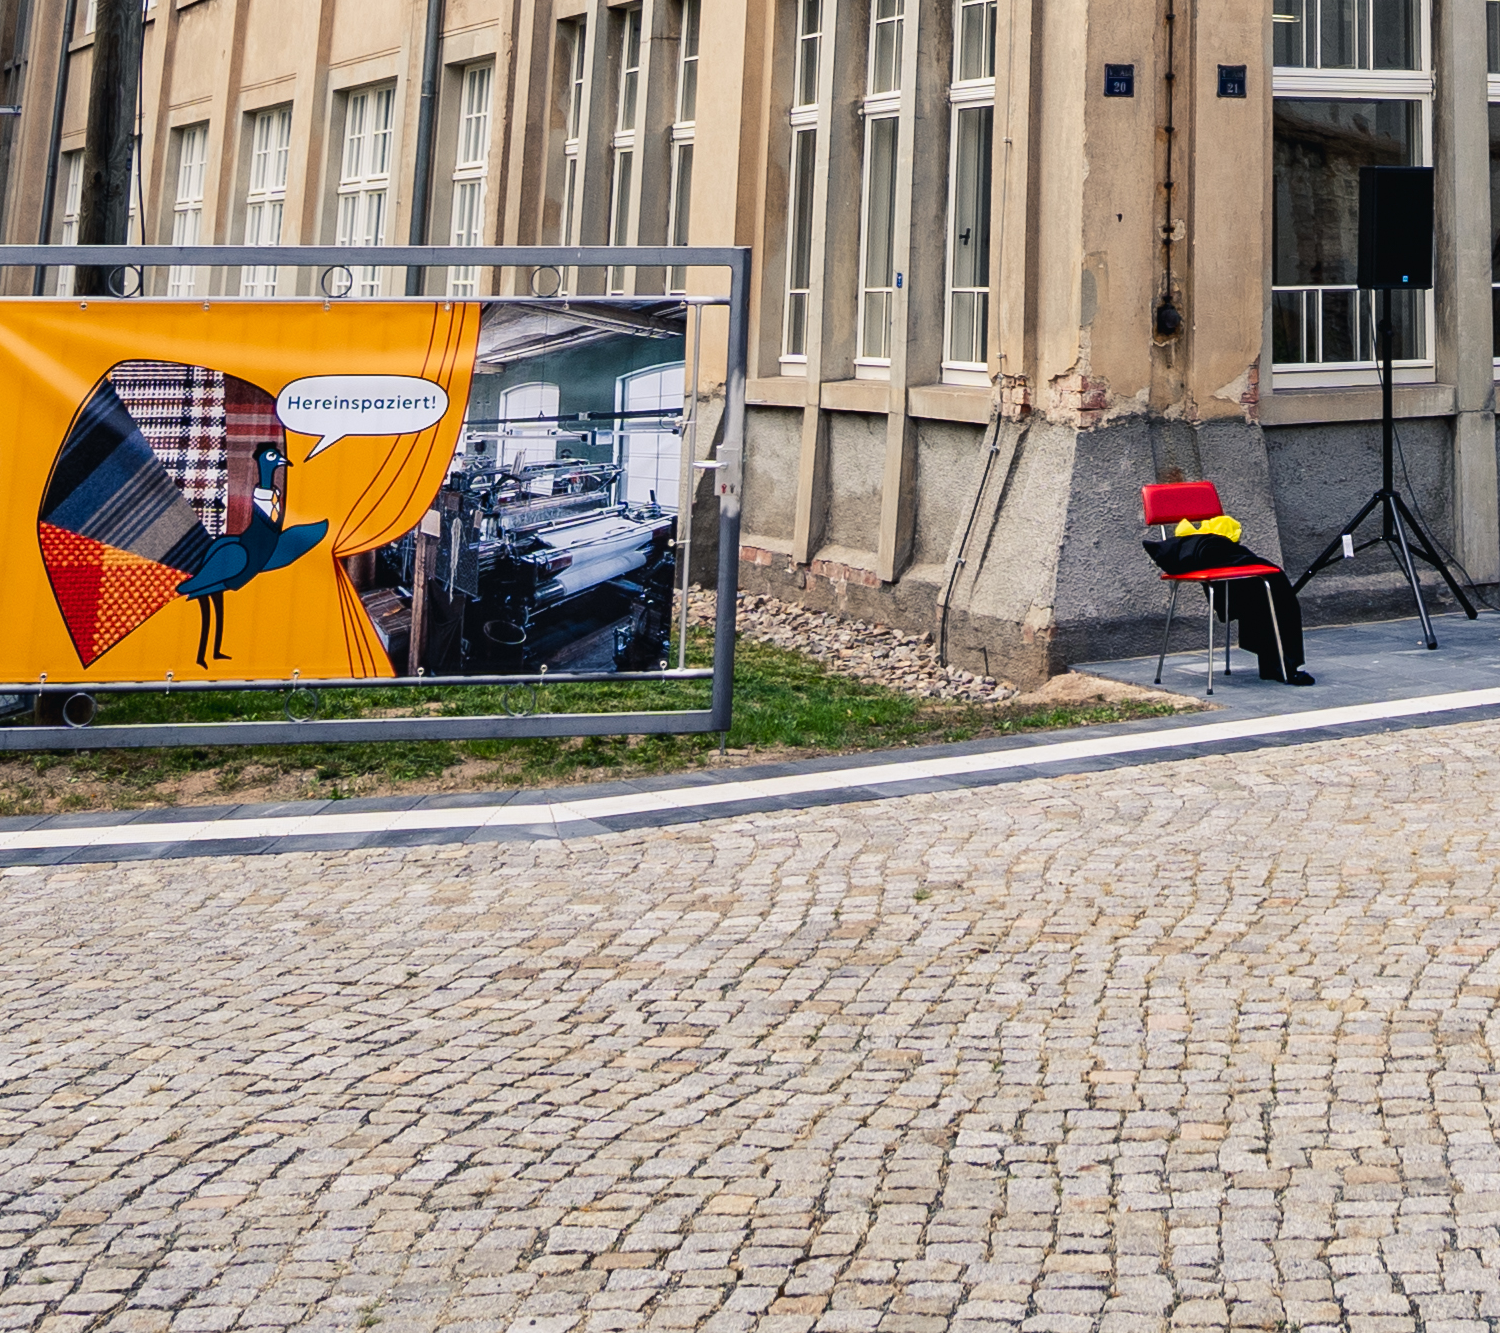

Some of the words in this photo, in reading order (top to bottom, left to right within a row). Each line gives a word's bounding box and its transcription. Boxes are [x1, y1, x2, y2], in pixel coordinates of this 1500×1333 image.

[1113, 81, 1126, 93] 20
[1226, 82, 1238, 94] 21
[287, 395, 436, 413] Hereinspaziert!
